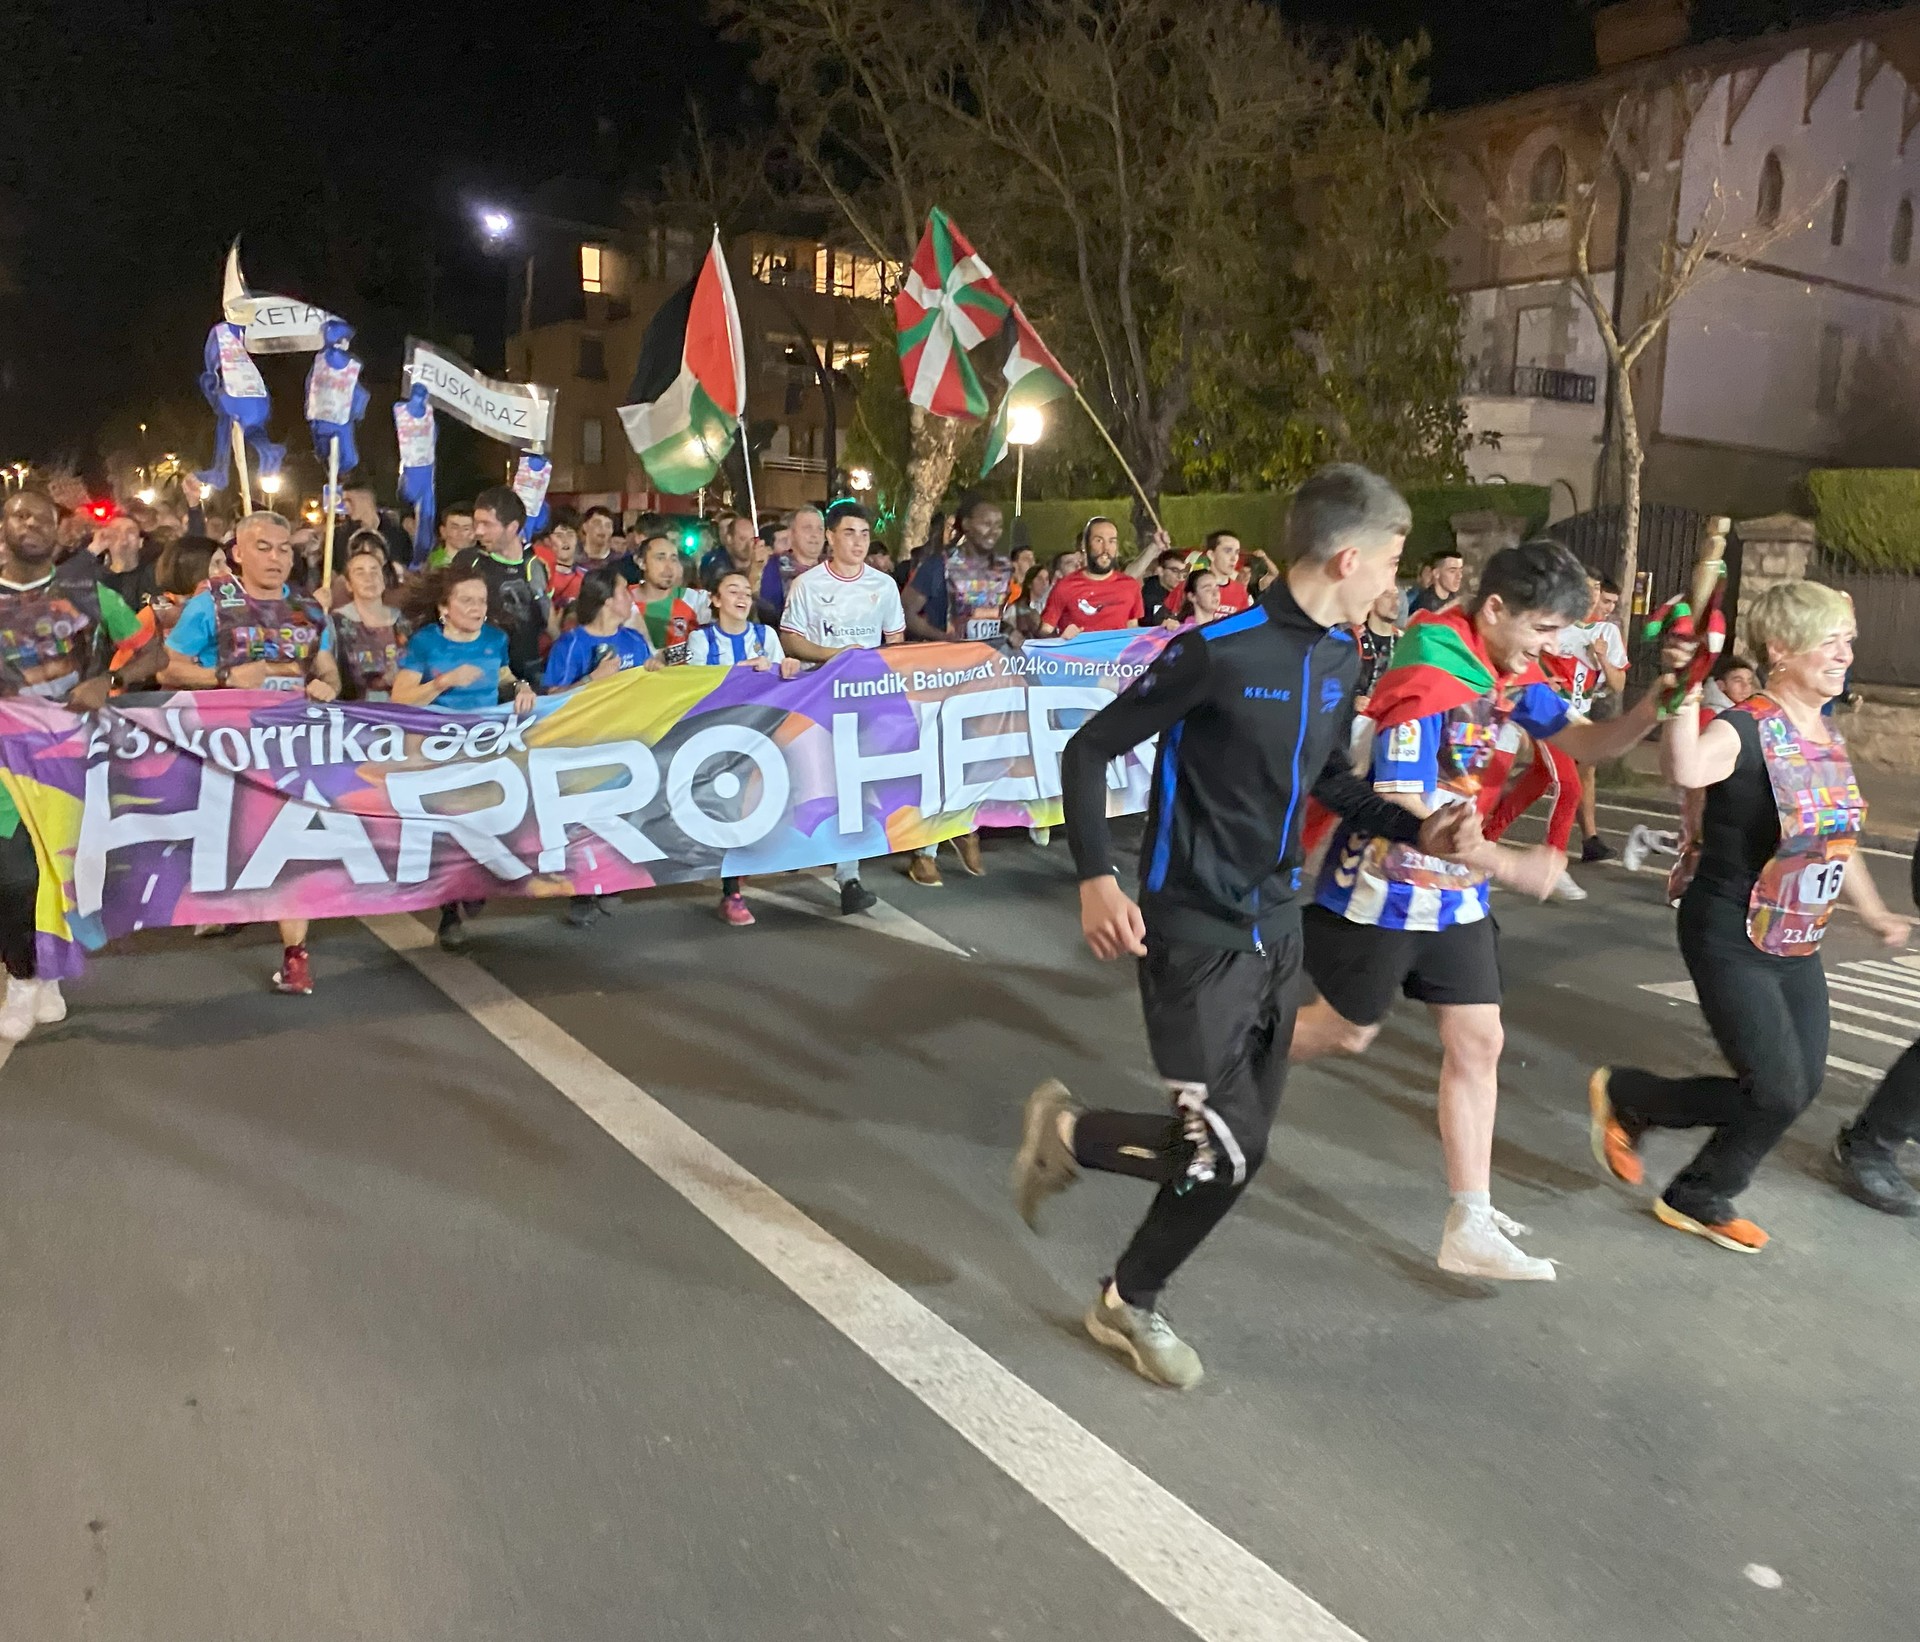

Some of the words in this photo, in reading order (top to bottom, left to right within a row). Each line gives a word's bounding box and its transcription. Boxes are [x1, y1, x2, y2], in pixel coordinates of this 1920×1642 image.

[420, 362, 528, 428] EUSKARAZ
[832, 676, 909, 699] Irundik
[913, 659, 996, 691] Baionarat
[1001, 655, 1058, 677] 2024ko
[1244, 686, 1291, 702] KELME
[421, 714, 537, 762] aek
[75, 724, 790, 917] HARRO
